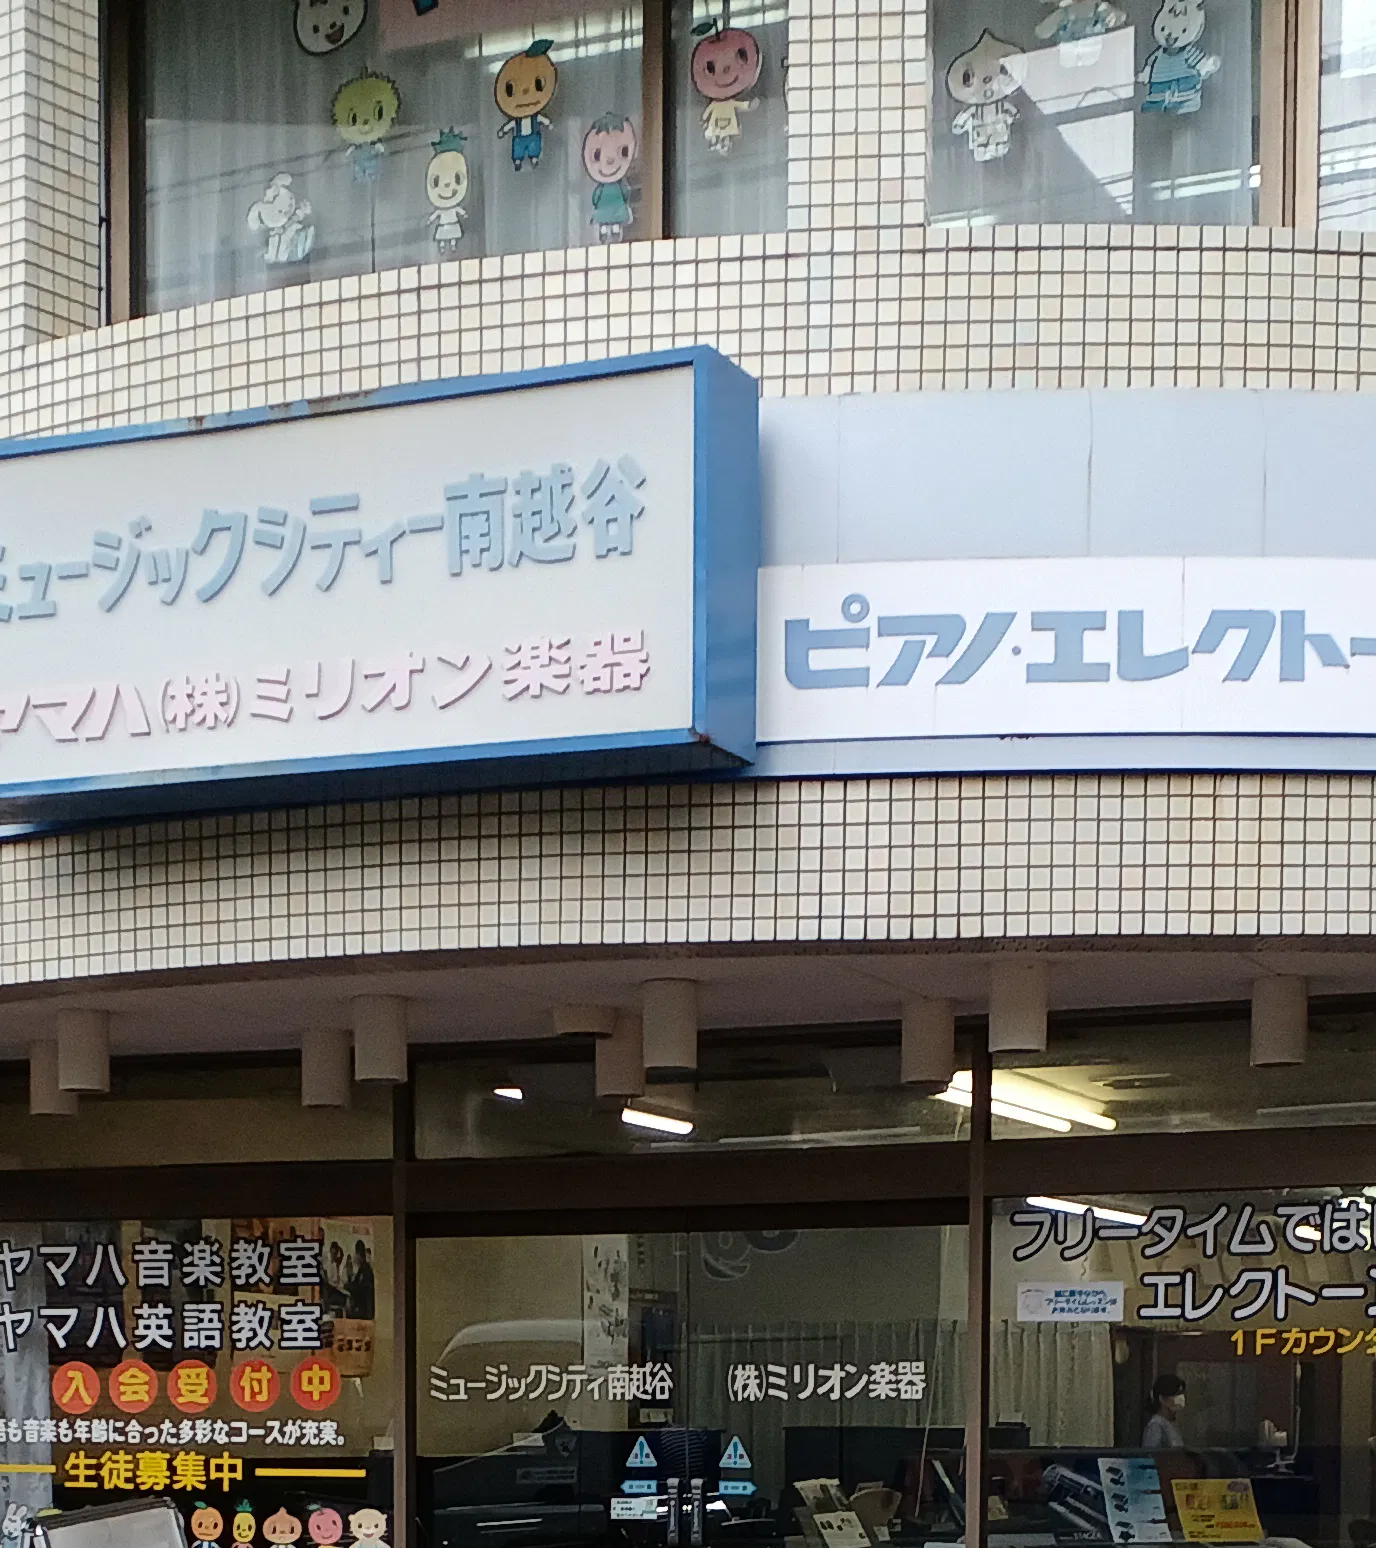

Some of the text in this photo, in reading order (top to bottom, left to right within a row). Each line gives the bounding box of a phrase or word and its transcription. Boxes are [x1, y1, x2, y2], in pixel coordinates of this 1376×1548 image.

[61, 1364, 332, 1406] 入会受付中
[429, 1360, 927, 1401] ミュージックシティ南越谷 (株)ミリオン楽器
[64, 1451, 243, 1492] 生徒募集中
